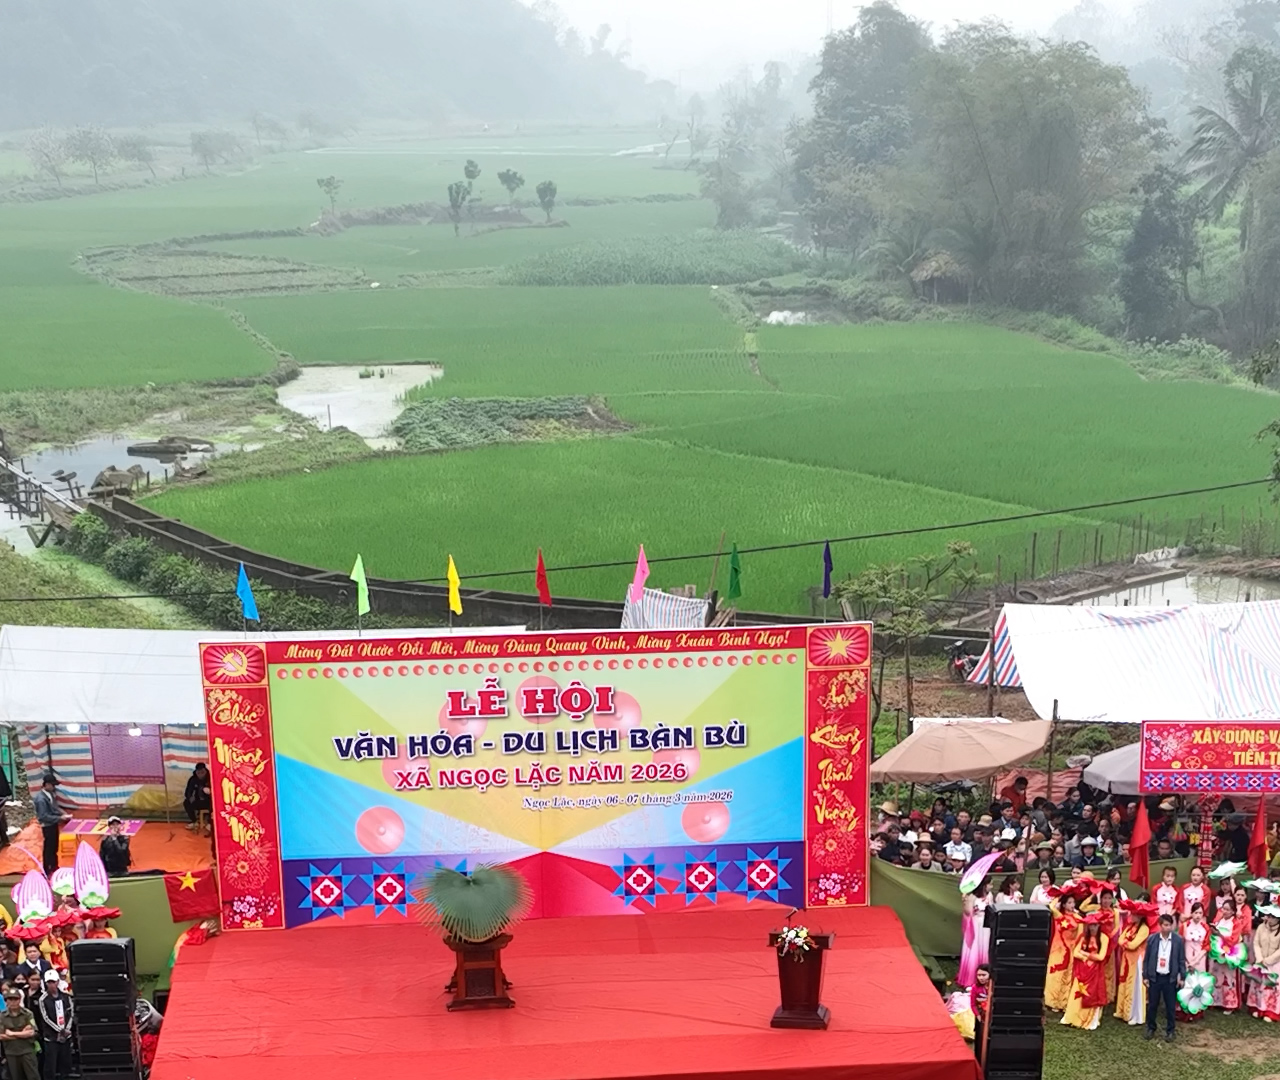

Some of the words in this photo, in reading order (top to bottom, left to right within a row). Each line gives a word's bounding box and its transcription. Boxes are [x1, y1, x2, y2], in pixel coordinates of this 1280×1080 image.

[283, 644, 323, 661] Mừng
[327, 643, 354, 658] Đất
[358, 642, 394, 657] Nước
[398, 640, 423, 656] Đổi
[426, 641, 458, 656] Mới,
[460, 640, 499, 656] Mừng
[503, 638, 541, 655] Đảng
[545, 637, 588, 654] Quang
[591, 635, 630, 651] Vinh,
[633, 634, 672, 651] Mừng
[675, 633, 714, 648] Xuân
[754, 630, 790, 645] Ngọ!
[448, 677, 507, 718] LỄ
[523, 681, 614, 720] HỘI
[334, 730, 396, 760] VĂN
[410, 727, 474, 757] HÓA
[503, 731, 546, 752] DU
[558, 729, 618, 758] LỊCH
[631, 722, 694, 752] BÀN
[705, 720, 746, 746] BÙ
[1193, 727, 1221, 744] XÂY
[1225, 727, 1265, 747] DỰNG
[1233, 749, 1265, 766] TIÊN
[395, 765, 432, 789] XÃ
[439, 768, 507, 791] NGỌC
[515, 763, 560, 789] LẶC
[568, 760, 623, 783] NĂM
[632, 763, 687, 781] 2026
